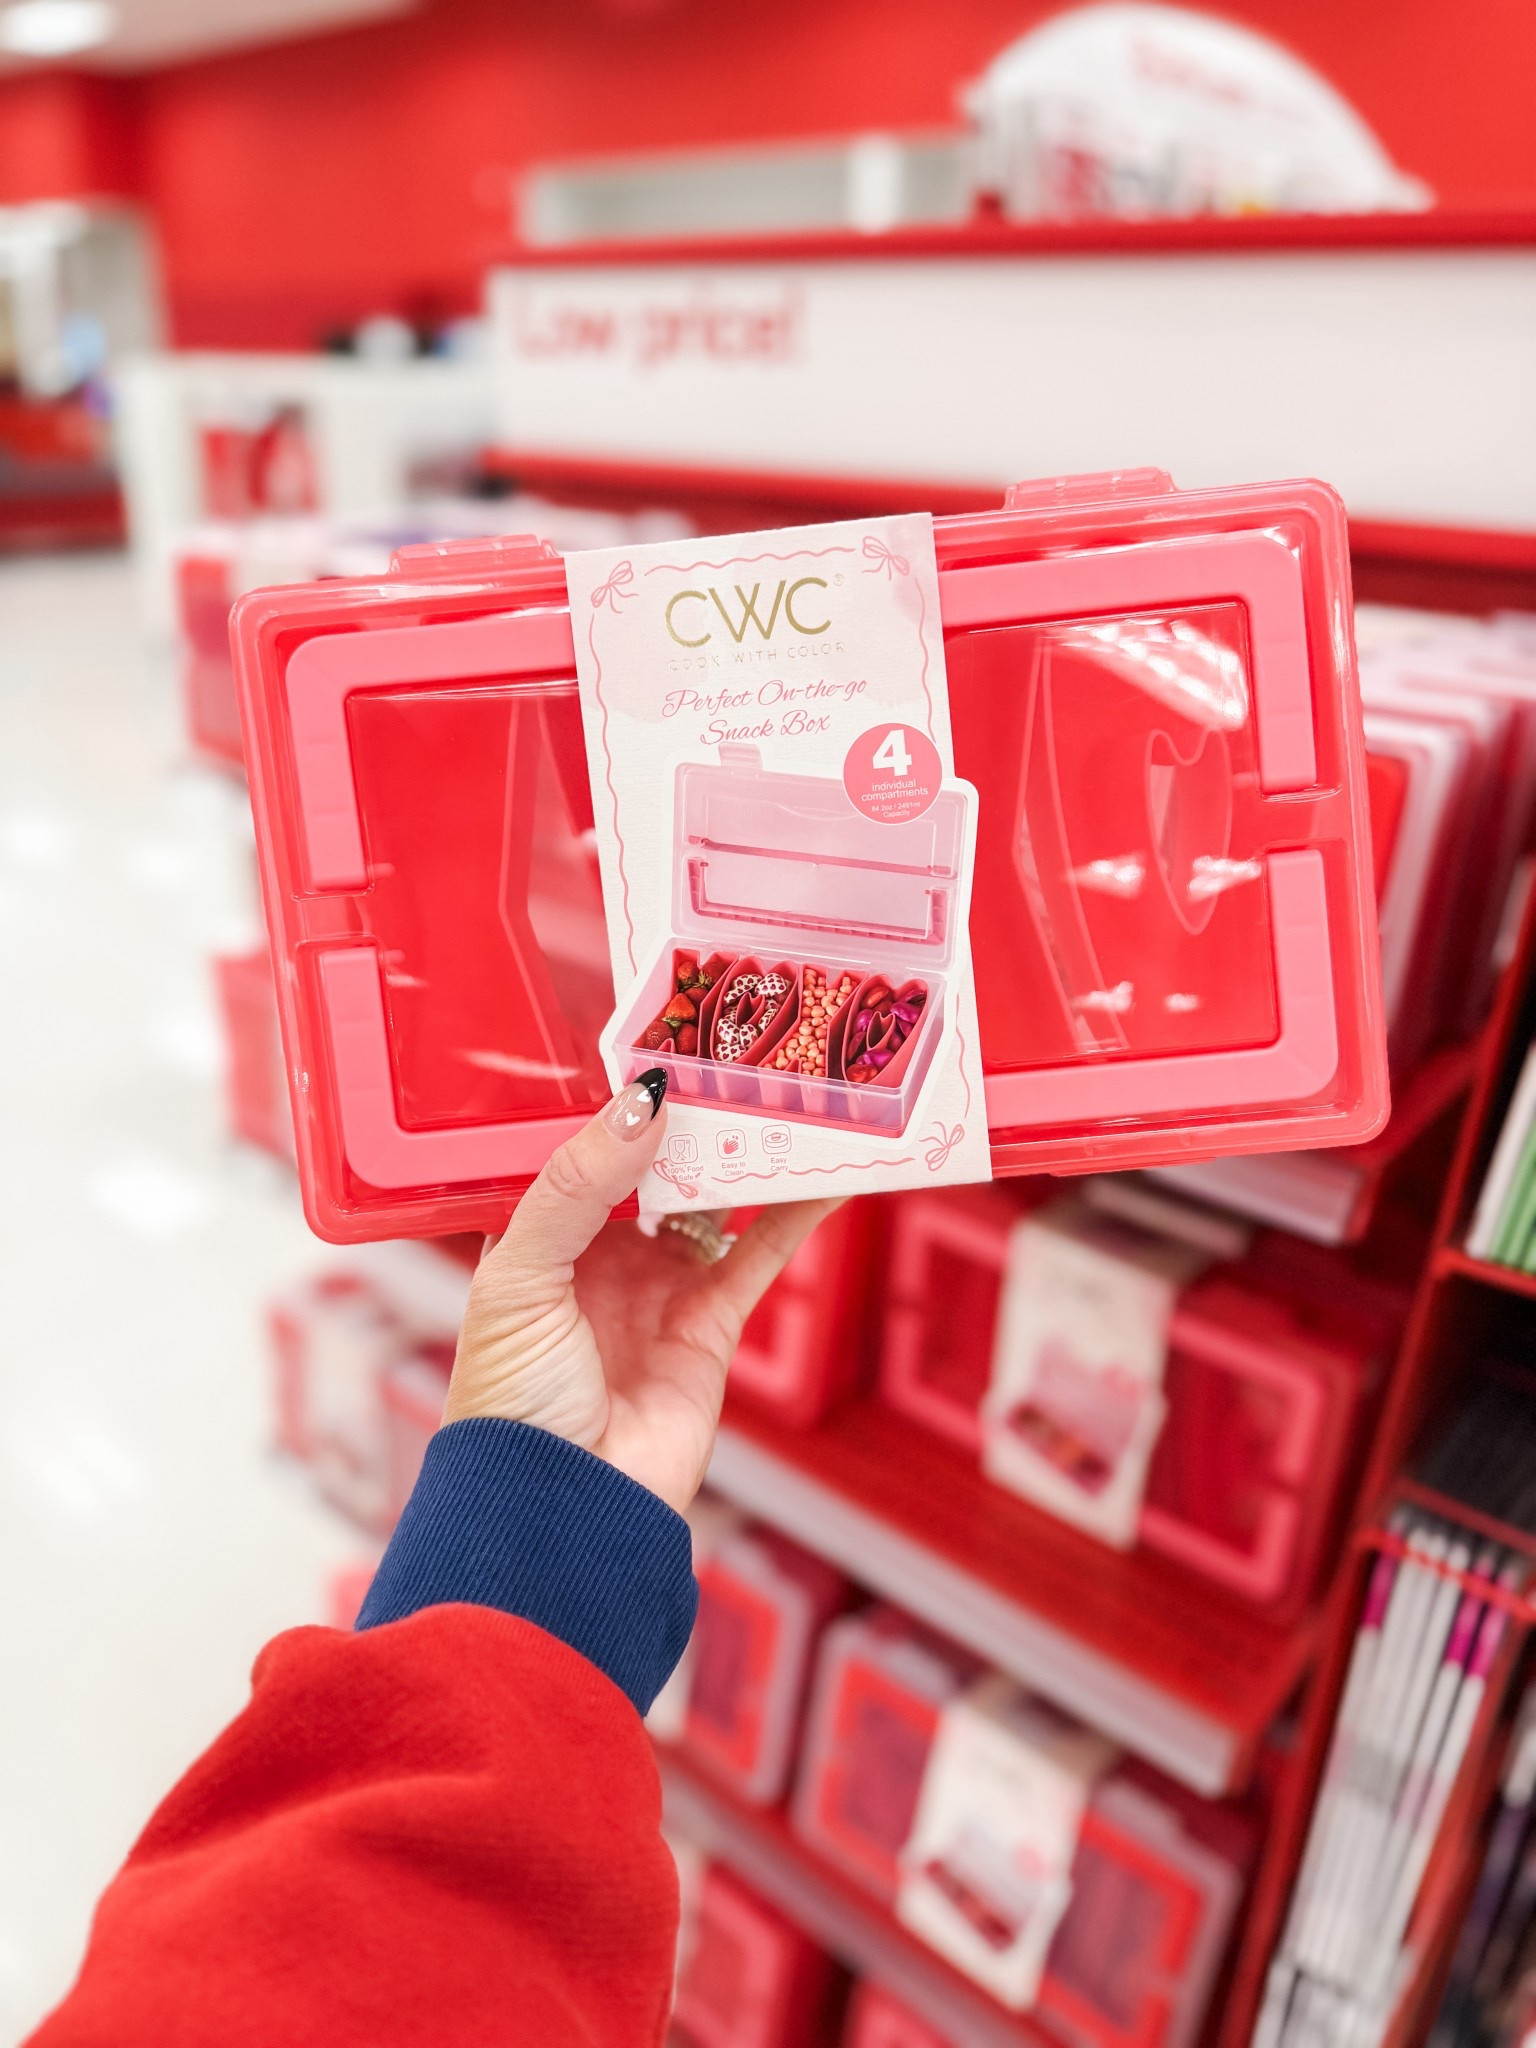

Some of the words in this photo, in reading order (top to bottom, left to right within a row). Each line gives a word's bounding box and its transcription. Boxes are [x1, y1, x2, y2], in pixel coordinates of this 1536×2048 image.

[665, 576, 832, 648] CWC
[668, 655, 721, 671] COOK
[733, 649, 778, 663] WITH
[787, 642, 845, 660] COLOR
[661, 688, 754, 717] Perfect
[757, 679, 869, 706] On-the-go
[700, 719, 775, 745] Snack
[780, 709, 832, 735] Box
[872, 729, 912, 777] 4
[871, 778, 917, 792] individual
[861, 787, 929, 802] compartments
[883, 810, 911, 818] Capacity
[721, 1162, 738, 1170] Easy
[770, 1157, 787, 1165] Easy
[667, 1166, 686, 1175] 100%
[687, 1165, 704, 1173] Food
[724, 1169, 745, 1177] Clean
[770, 1165, 789, 1173] Carry
[678, 1174, 694, 1182] Safe
